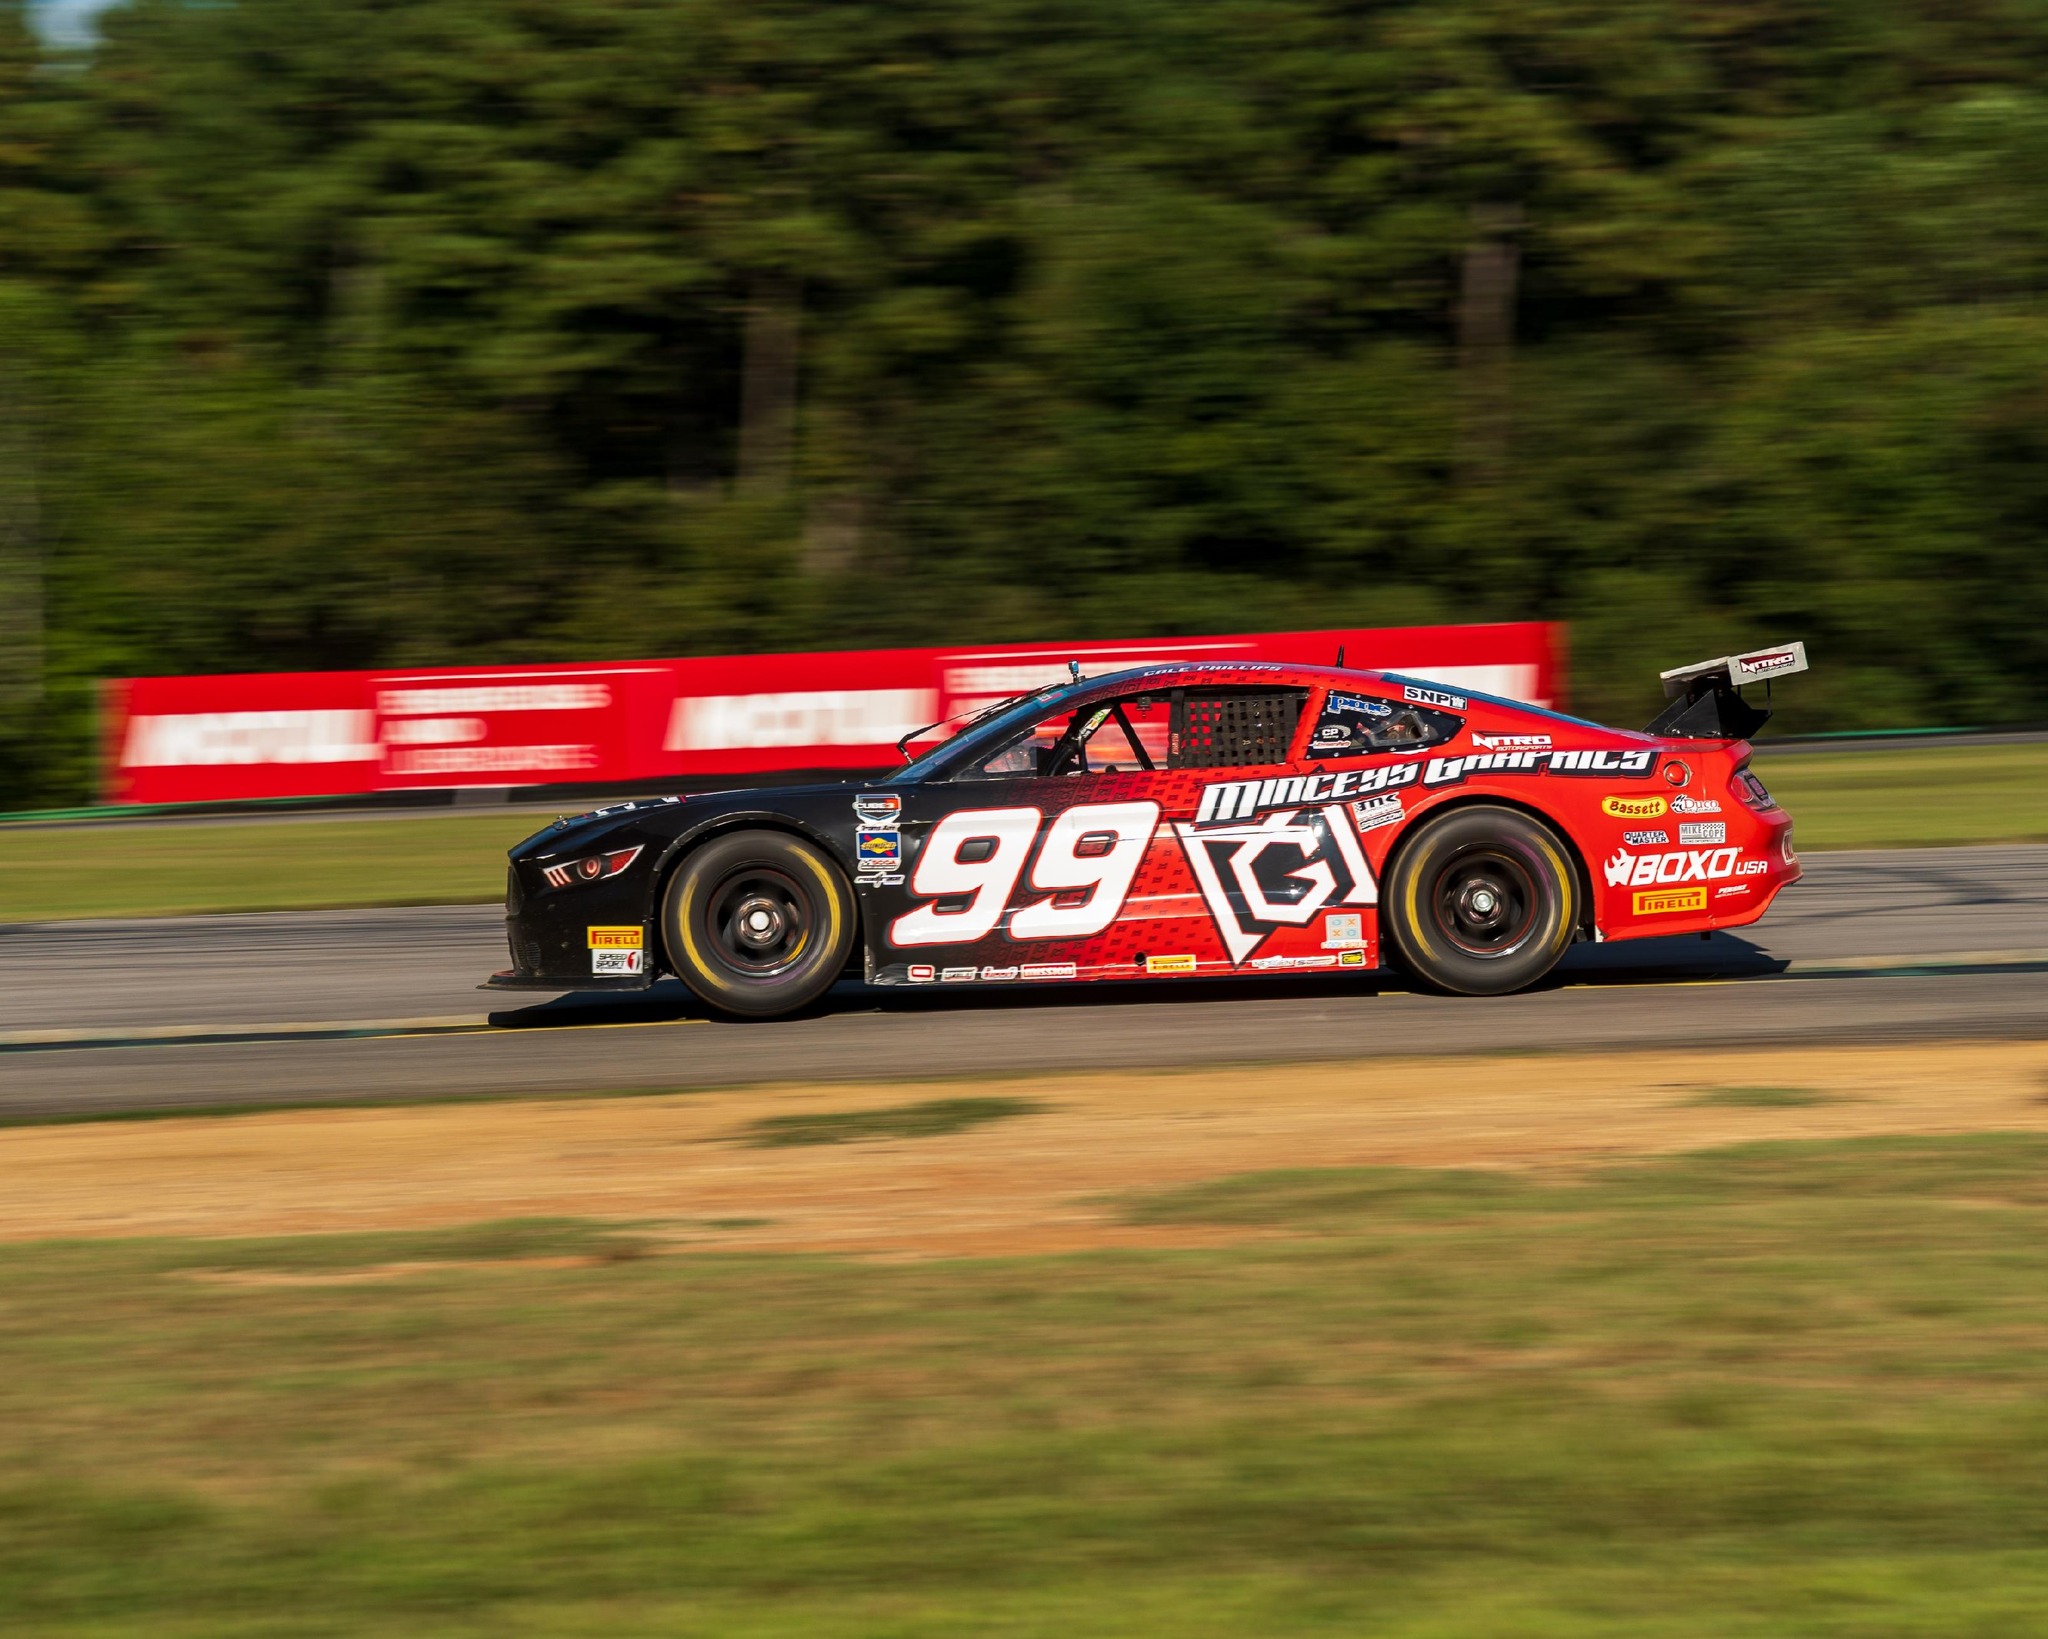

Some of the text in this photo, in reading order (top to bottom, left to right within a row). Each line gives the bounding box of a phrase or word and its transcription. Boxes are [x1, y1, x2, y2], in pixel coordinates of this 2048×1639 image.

[1740, 654, 1794, 673] NITRO
[1406, 688, 1449, 703] SNP
[1321, 728, 1339, 736] CP
[1471, 733, 1552, 750] NITRO
[1609, 800, 1661, 815] Bassett
[1624, 831, 1665, 841] QUARTER
[1681, 826, 1702, 835] MIKE
[1702, 829, 1725, 839] COPE
[888, 800, 1161, 948] 99
[1630, 847, 1738, 886] BOXO
[1735, 861, 1768, 876] USA
[1638, 891, 1702, 911] PIRELLI
[591, 930, 640, 945] PIRELLI
[596, 960, 625, 968] SPORT
